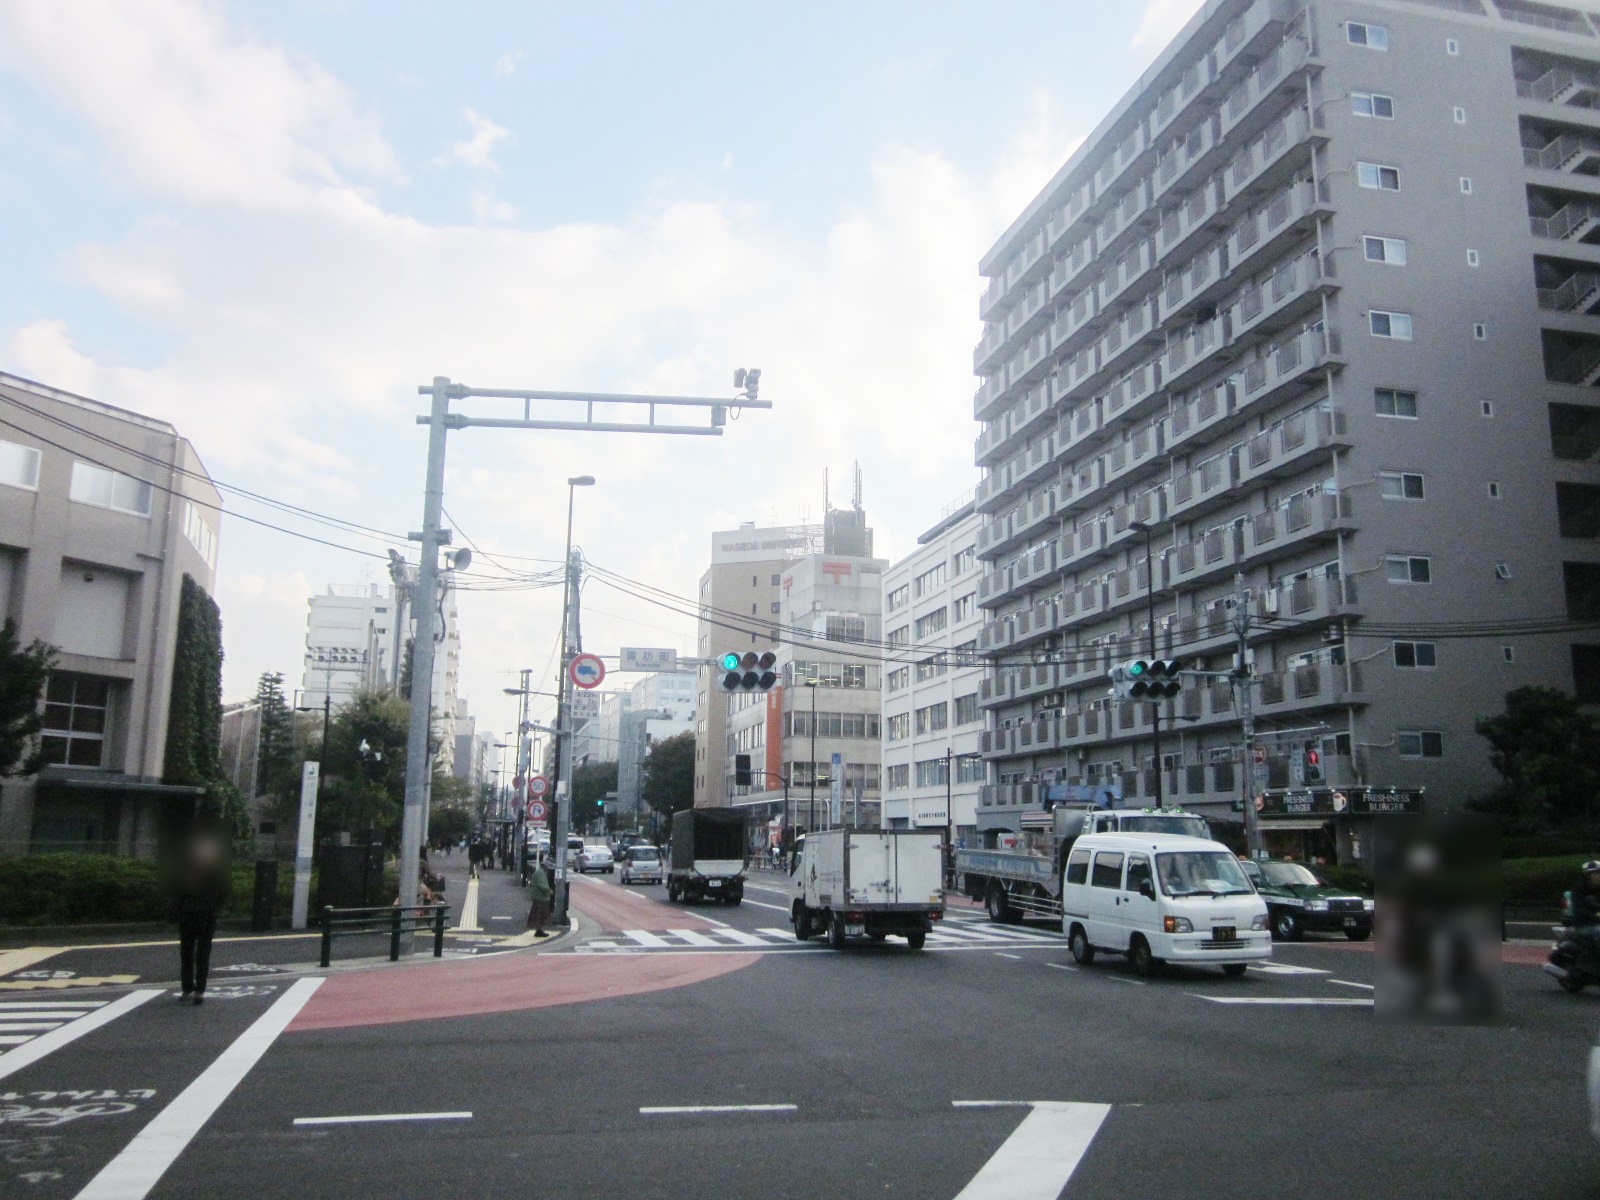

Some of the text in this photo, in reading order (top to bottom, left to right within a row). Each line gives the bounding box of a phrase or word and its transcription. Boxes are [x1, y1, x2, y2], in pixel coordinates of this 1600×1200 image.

[721, 541, 759, 552] WASEDA
[532, 781, 544, 791] 50
[1283, 794, 1314, 804] FRESHNESS
[1363, 793, 1410, 802] FRESHNESS
[1287, 804, 1311, 813] BURGER
[1369, 803, 1405, 812] BURGER
